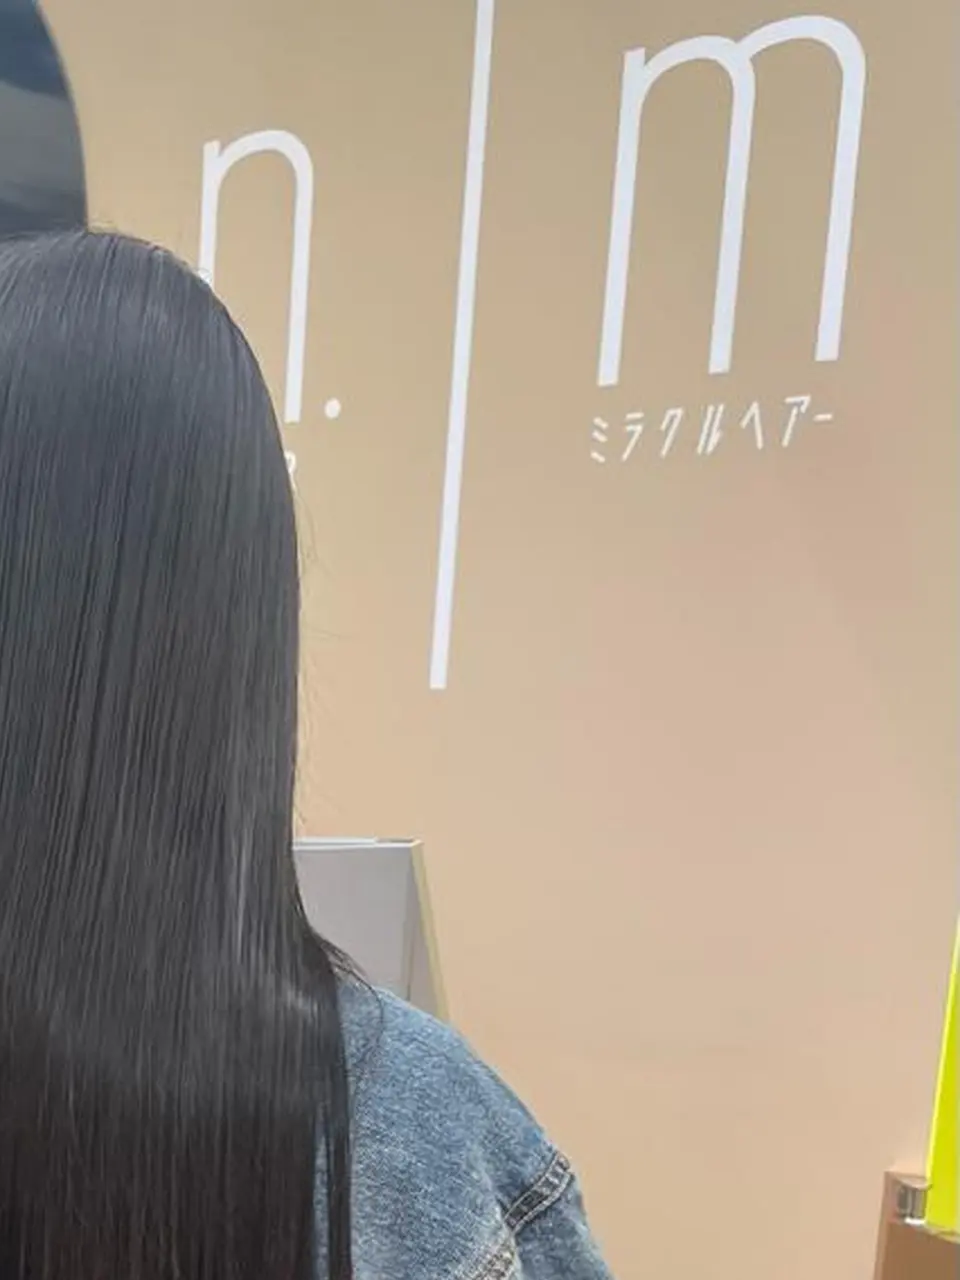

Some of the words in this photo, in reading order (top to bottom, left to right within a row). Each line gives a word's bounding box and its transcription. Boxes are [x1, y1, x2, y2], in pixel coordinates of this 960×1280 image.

[590, 395, 833, 463] ミラクルヘアー
